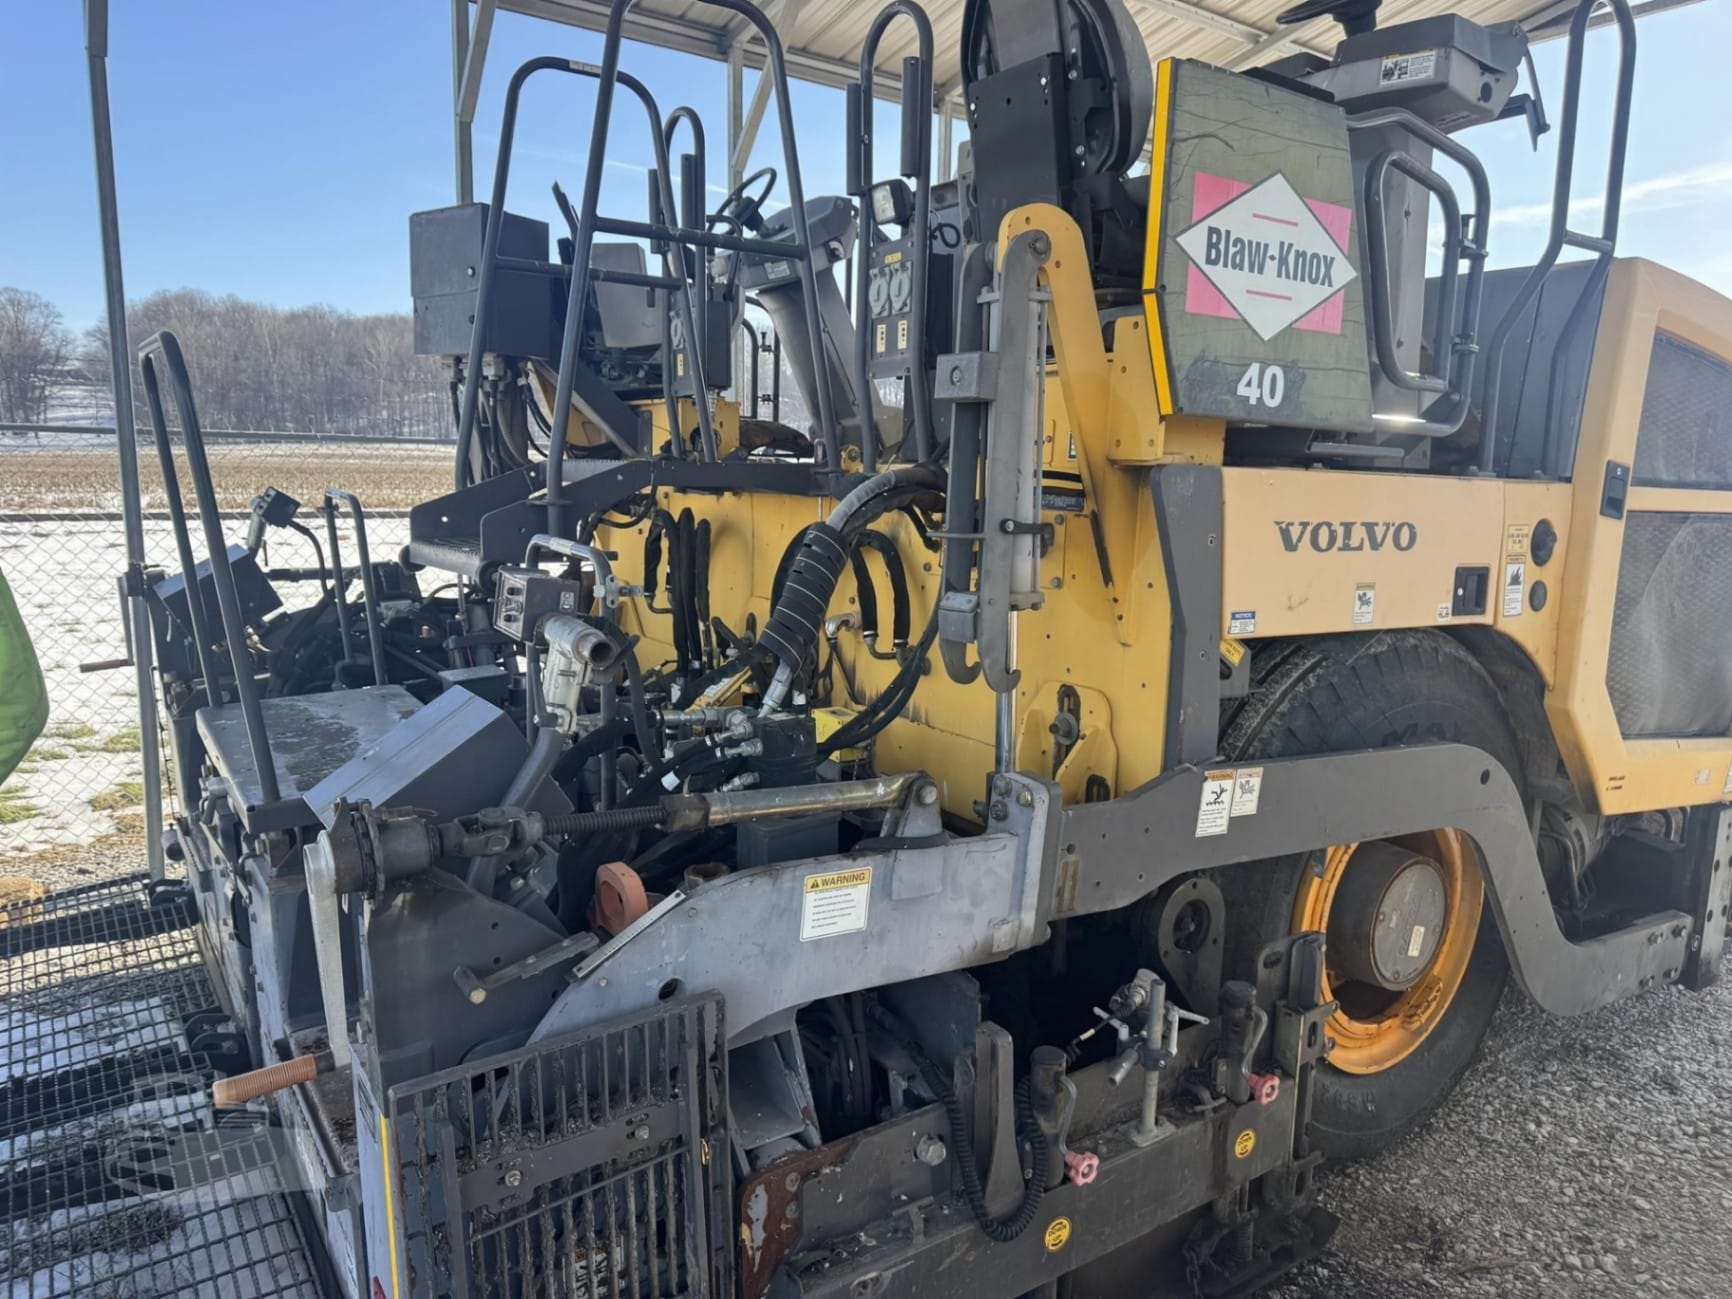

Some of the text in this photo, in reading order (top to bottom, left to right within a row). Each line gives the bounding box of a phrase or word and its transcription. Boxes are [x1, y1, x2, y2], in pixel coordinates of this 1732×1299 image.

[1236, 362, 1285, 408] 40
[1273, 520, 1418, 552] VOLVO
[820, 872, 866, 888] WARNING
